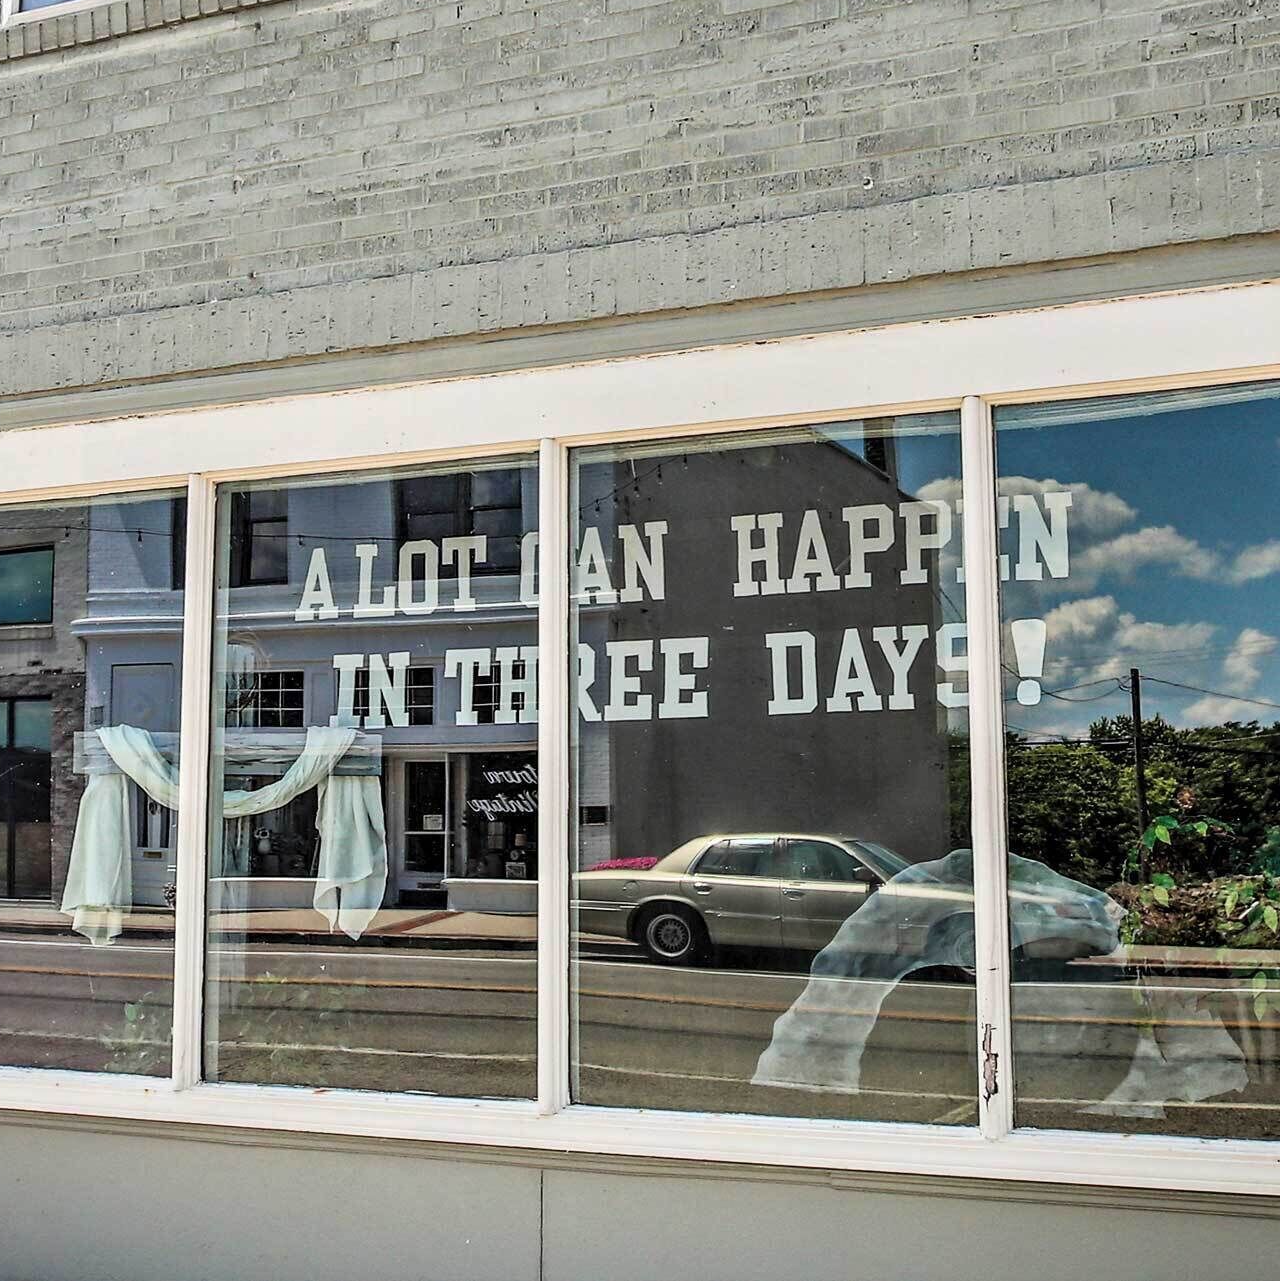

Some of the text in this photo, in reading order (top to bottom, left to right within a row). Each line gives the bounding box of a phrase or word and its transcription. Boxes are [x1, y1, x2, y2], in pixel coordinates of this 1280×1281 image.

[353, 535, 487, 618] LOT
[329, 651, 410, 729] IN
[444, 637, 709, 726] THREE
